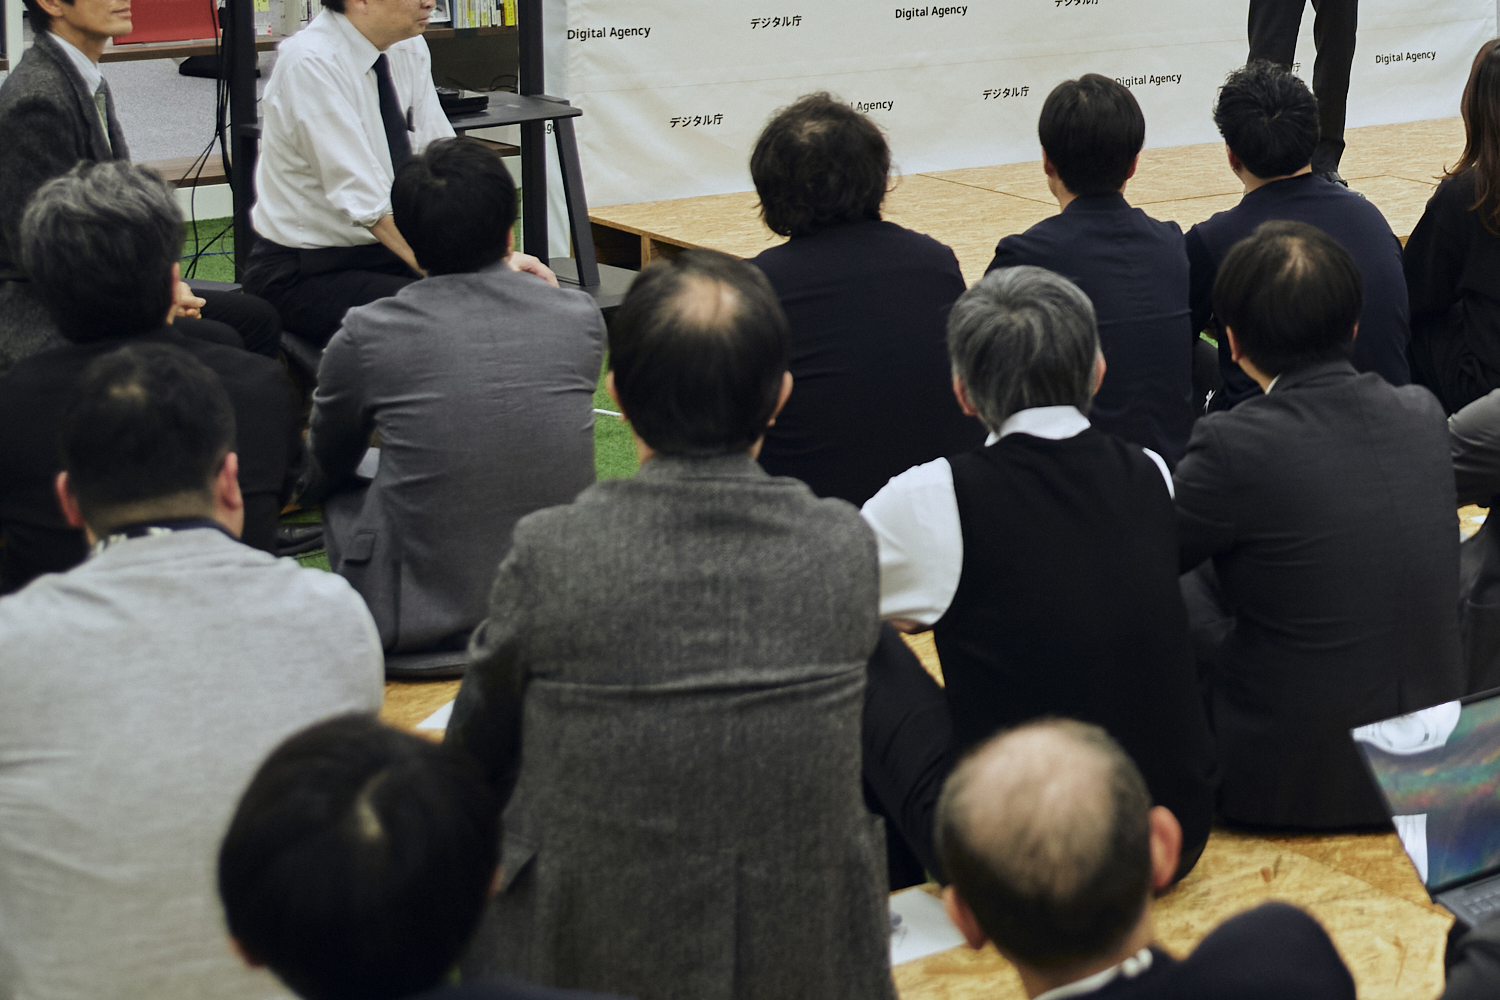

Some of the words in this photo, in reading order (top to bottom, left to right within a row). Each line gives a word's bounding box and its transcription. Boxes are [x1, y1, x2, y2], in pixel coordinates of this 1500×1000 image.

[896, 7, 928, 20] Digital
[932, 6, 967, 18] Agency
[751, 15, 802, 29] デジタル庁
[567, 27, 605, 41] Digital
[610, 27, 650, 39] Agency
[1376, 53, 1403, 65] Digital
[1406, 52, 1436, 62] Agency
[1115, 75, 1147, 89] Digital
[1149, 75, 1181, 86] Agency
[983, 86, 1029, 100] デジタル庁
[856, 100, 894, 112] Agency
[670, 114, 723, 128] デジタル庁
